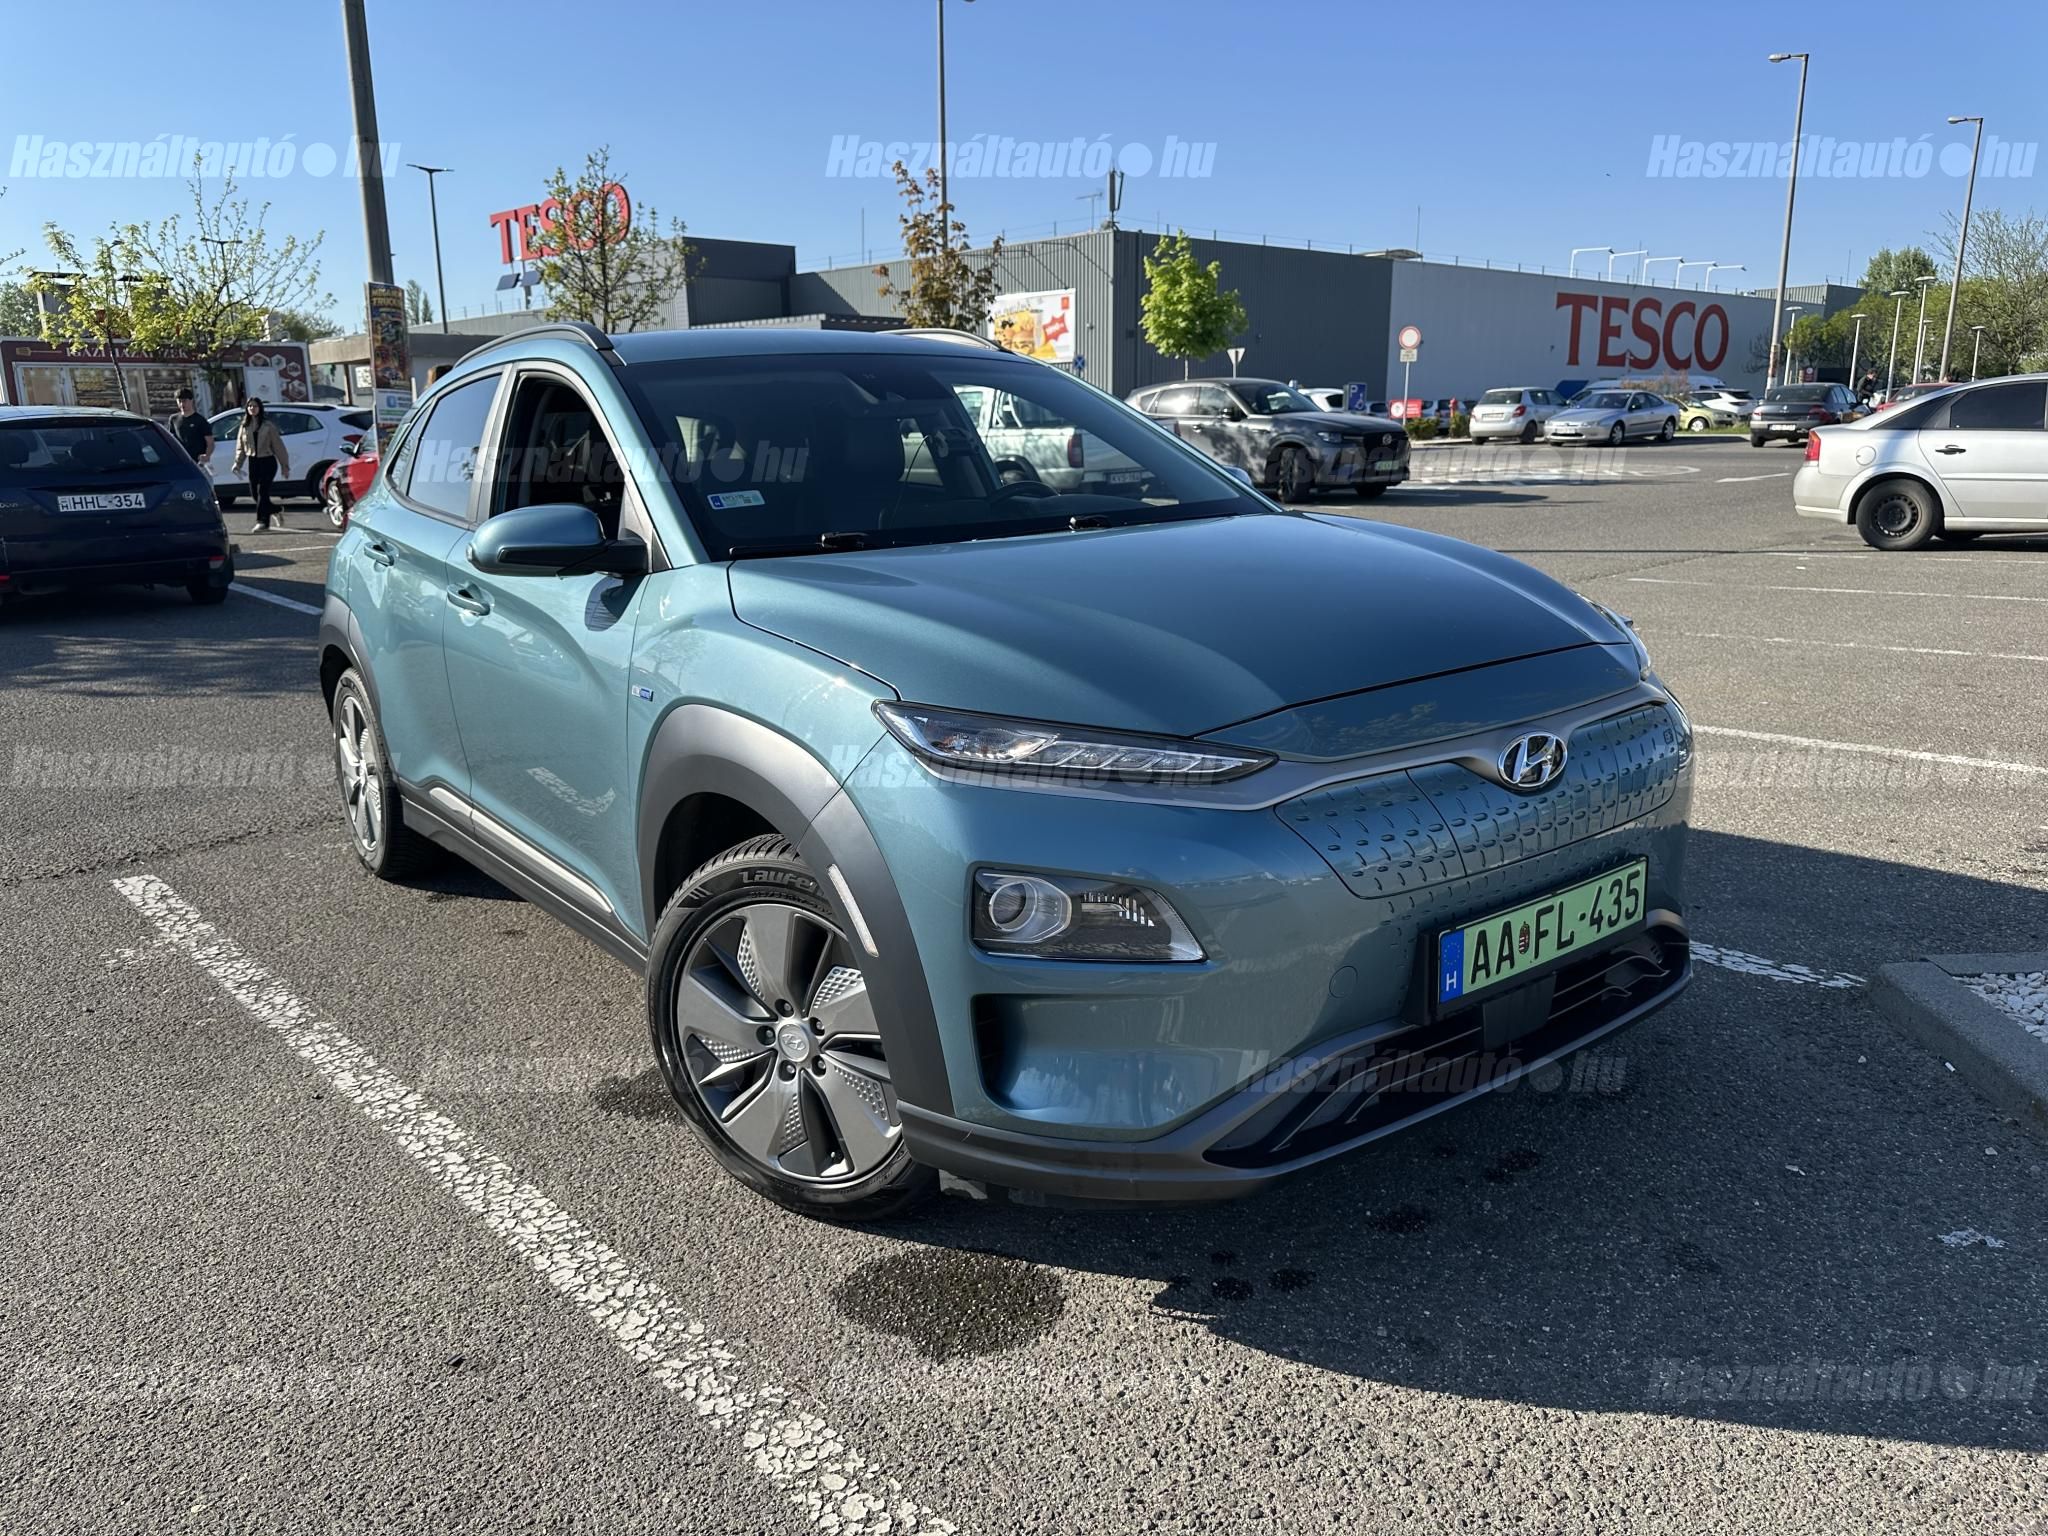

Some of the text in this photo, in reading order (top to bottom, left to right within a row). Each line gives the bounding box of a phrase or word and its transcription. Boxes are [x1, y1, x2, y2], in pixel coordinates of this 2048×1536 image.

[490, 182, 631, 264] TESCO
[1556, 292, 1729, 371] TESCO
[72, 494, 143, 509] HHL-354
[1445, 971, 1457, 992] H
[1470, 920, 1515, 985] AA
